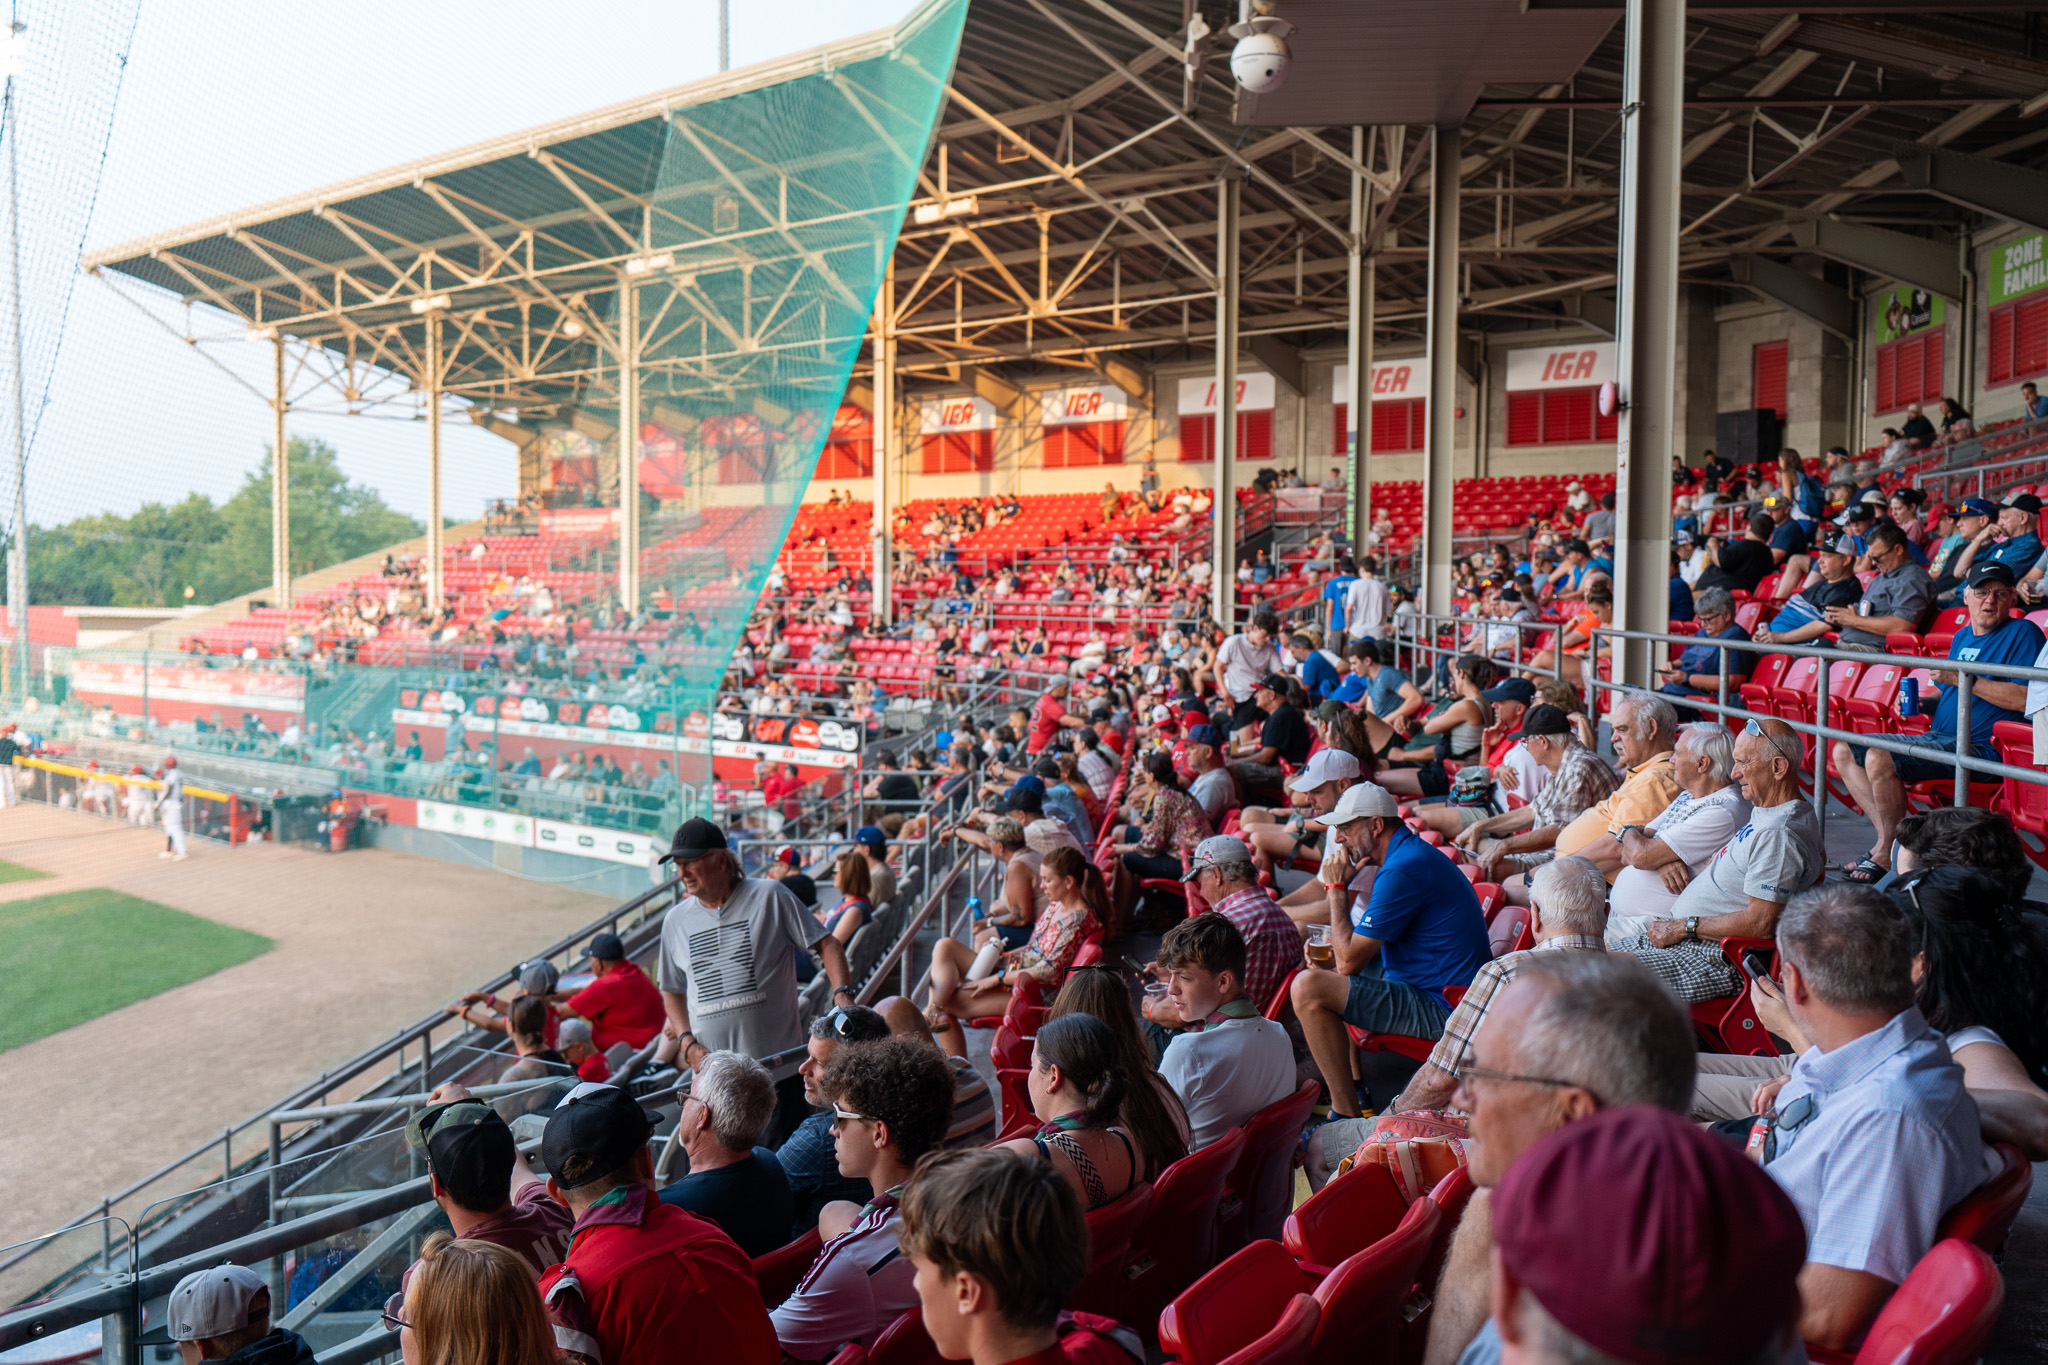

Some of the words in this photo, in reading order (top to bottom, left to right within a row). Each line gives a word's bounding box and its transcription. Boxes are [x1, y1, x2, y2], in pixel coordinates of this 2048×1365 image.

[2004, 235, 2043, 270] ZONE
[2003, 258, 2048, 296] FAMIL
[1541, 350, 1597, 382] IGA
[1065, 392, 1102, 417] IGA
[1204, 380, 1247, 407] IA
[942, 403, 975, 426] IGA
[1760, 883, 1778, 892] SINCE
[722, 991, 767, 1010] ARMOUR
